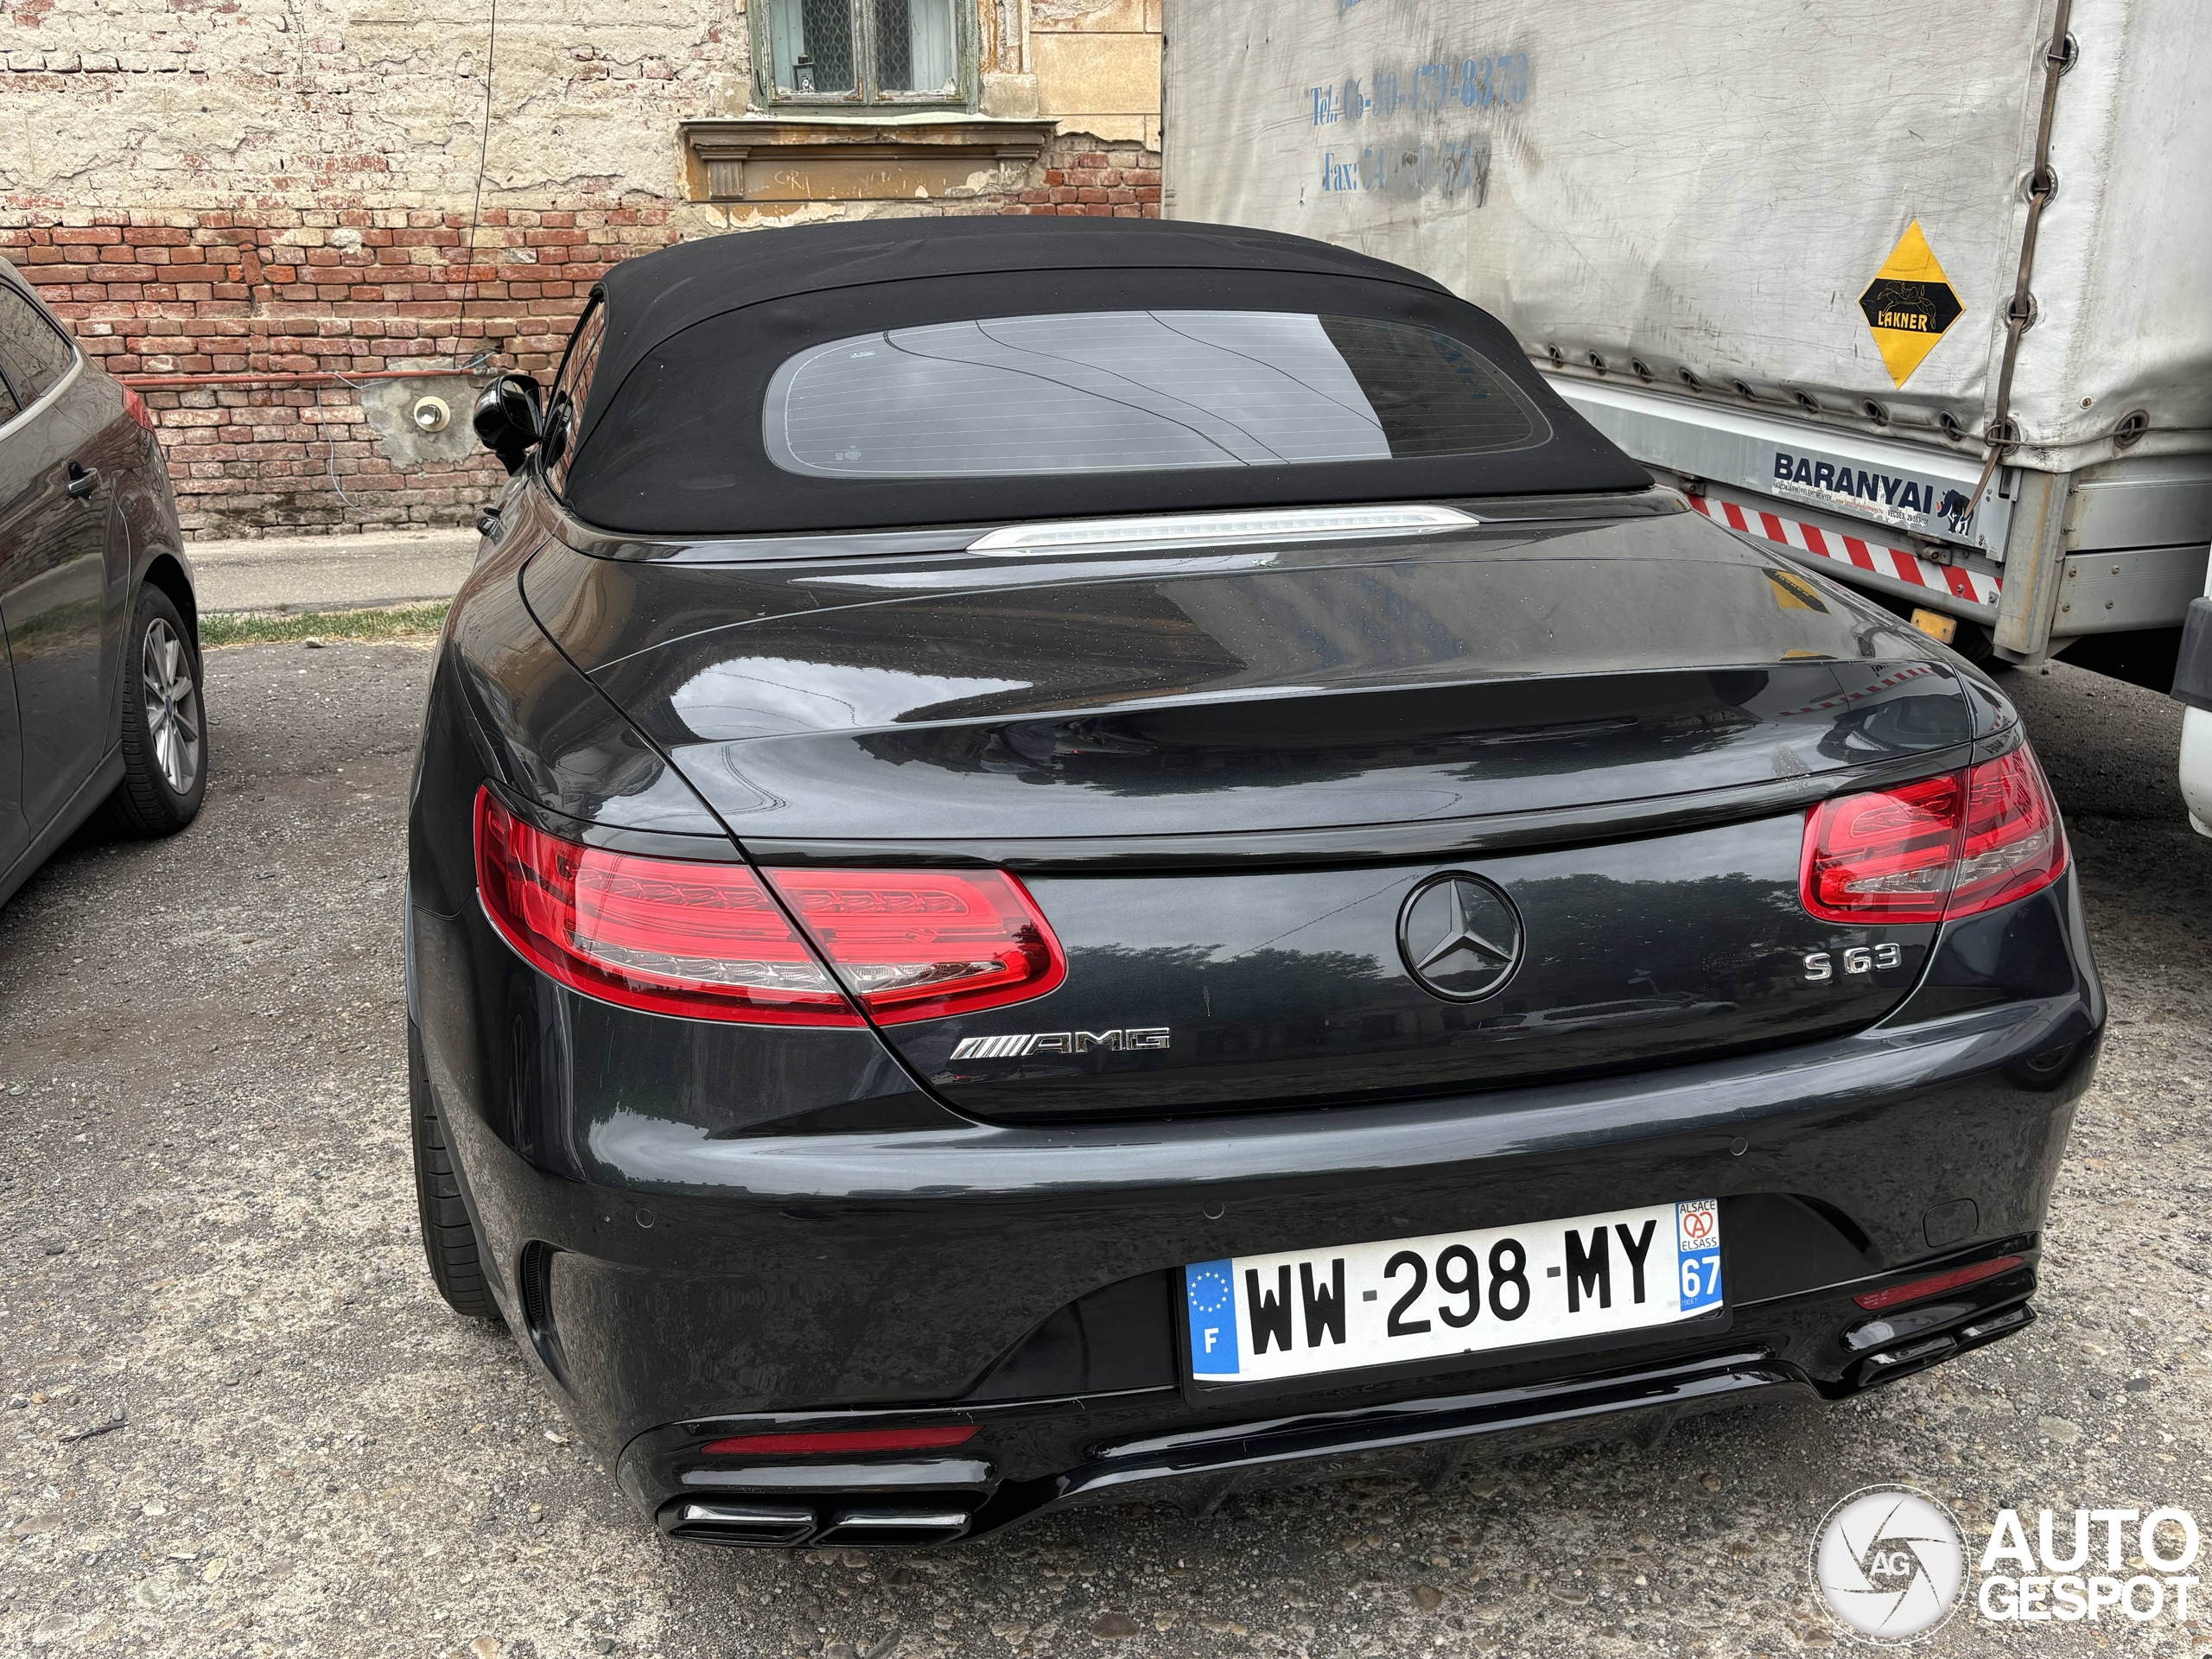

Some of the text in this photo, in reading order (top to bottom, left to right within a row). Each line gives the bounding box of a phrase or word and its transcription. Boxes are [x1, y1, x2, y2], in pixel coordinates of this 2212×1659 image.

[1324, 151, 1357, 192] Fax:
[1878, 310, 1928, 332] LAKNER
[1773, 452, 1934, 515] BARANYAI
[1803, 942, 1902, 981] S 63
[1021, 1027, 1171, 1056] AMG
[1679, 1200, 1716, 1214] ALSACE
[1681, 1236, 1718, 1251] ELSASS
[1204, 1327, 1220, 1354] F
[1681, 1255, 1720, 1298] 67
